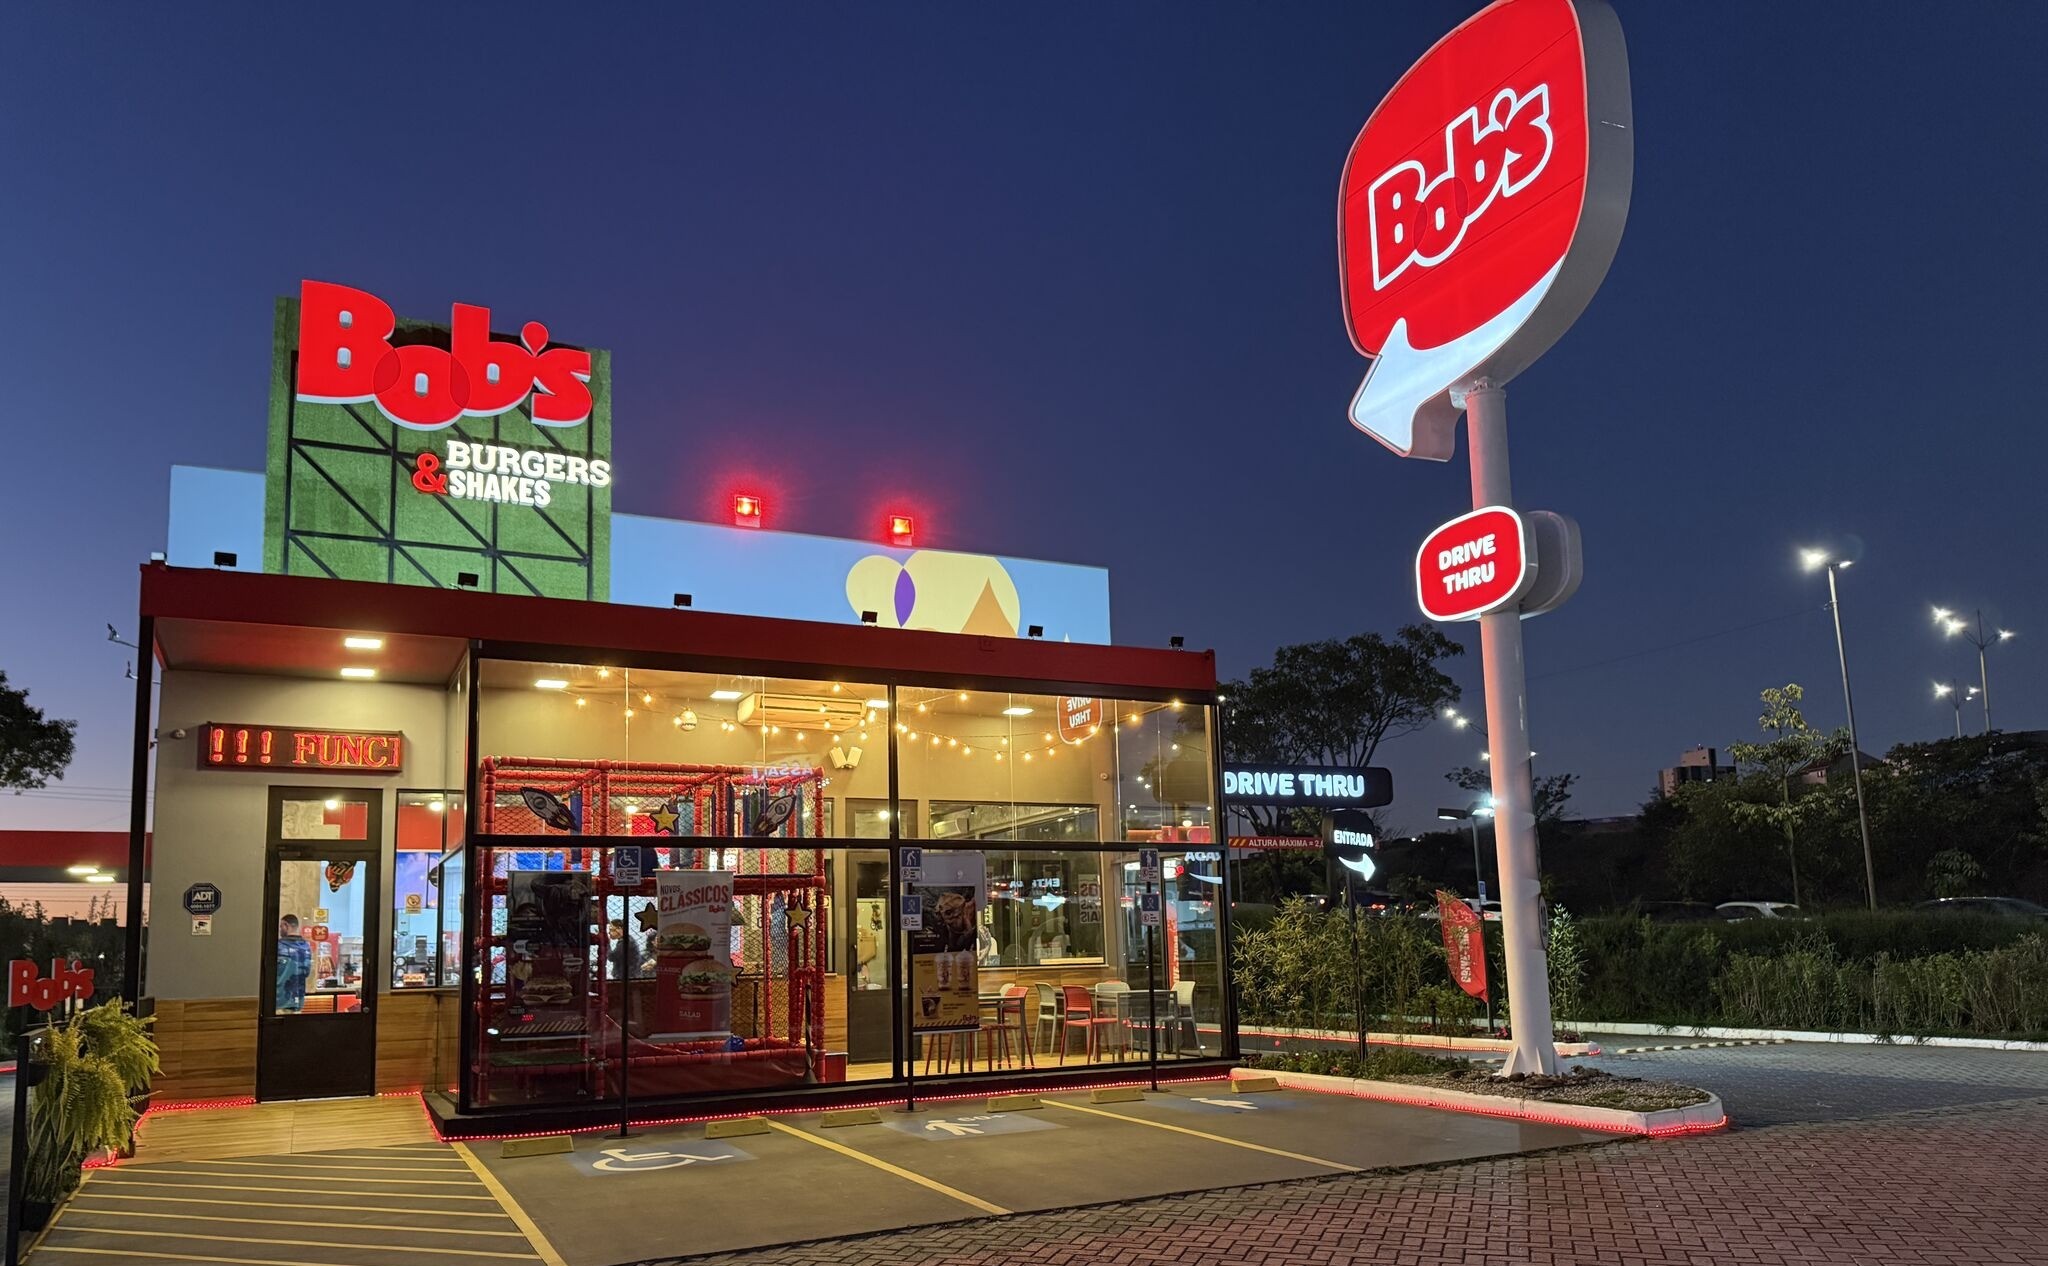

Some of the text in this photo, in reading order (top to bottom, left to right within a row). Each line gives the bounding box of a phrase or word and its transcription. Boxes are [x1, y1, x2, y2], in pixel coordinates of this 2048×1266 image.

[1368, 83, 1553, 291] Bob's
[297, 280, 592, 431] Bob's
[446, 439, 612, 488] BURGERS
[412, 452, 551, 508] & SHAKES
[1438, 534, 1496, 571] DRIVE
[1443, 561, 1496, 595] THRU
[1224, 771, 1365, 798] DRIVE THRU
[1249, 838, 1278, 847] ALTURA
[1279, 837, 1308, 847] MÁXIMA
[1333, 829, 1374, 848] ENTRADA
[193, 891, 214, 901] ADT
[660, 884, 681, 895] NOVOS
[660, 885, 729, 912] CLÁSSICOS
[7, 957, 95, 1012] Bob's
[679, 1010, 701, 1018] SALAD
